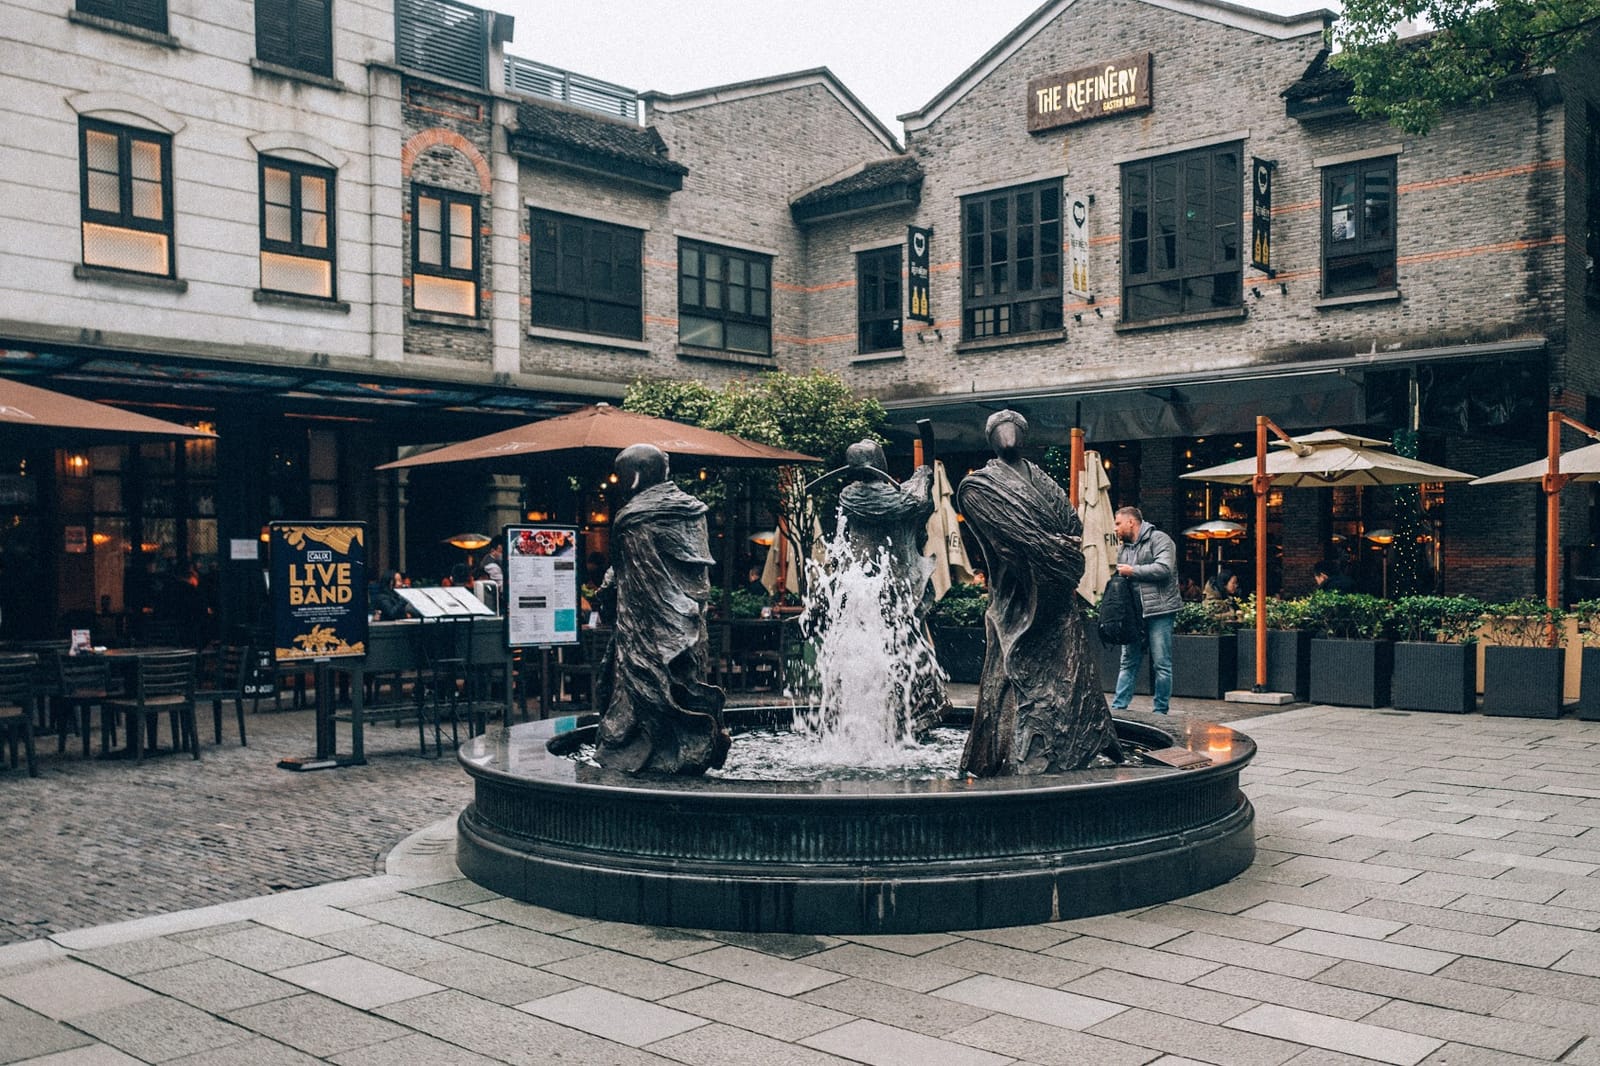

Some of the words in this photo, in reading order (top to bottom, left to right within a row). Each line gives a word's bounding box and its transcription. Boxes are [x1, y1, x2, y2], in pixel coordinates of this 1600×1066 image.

[1036, 85, 1062, 114] THE
[1066, 65, 1138, 113] REFINERY
[289, 563, 352, 586] LIVE
[289, 586, 353, 605] BAND
